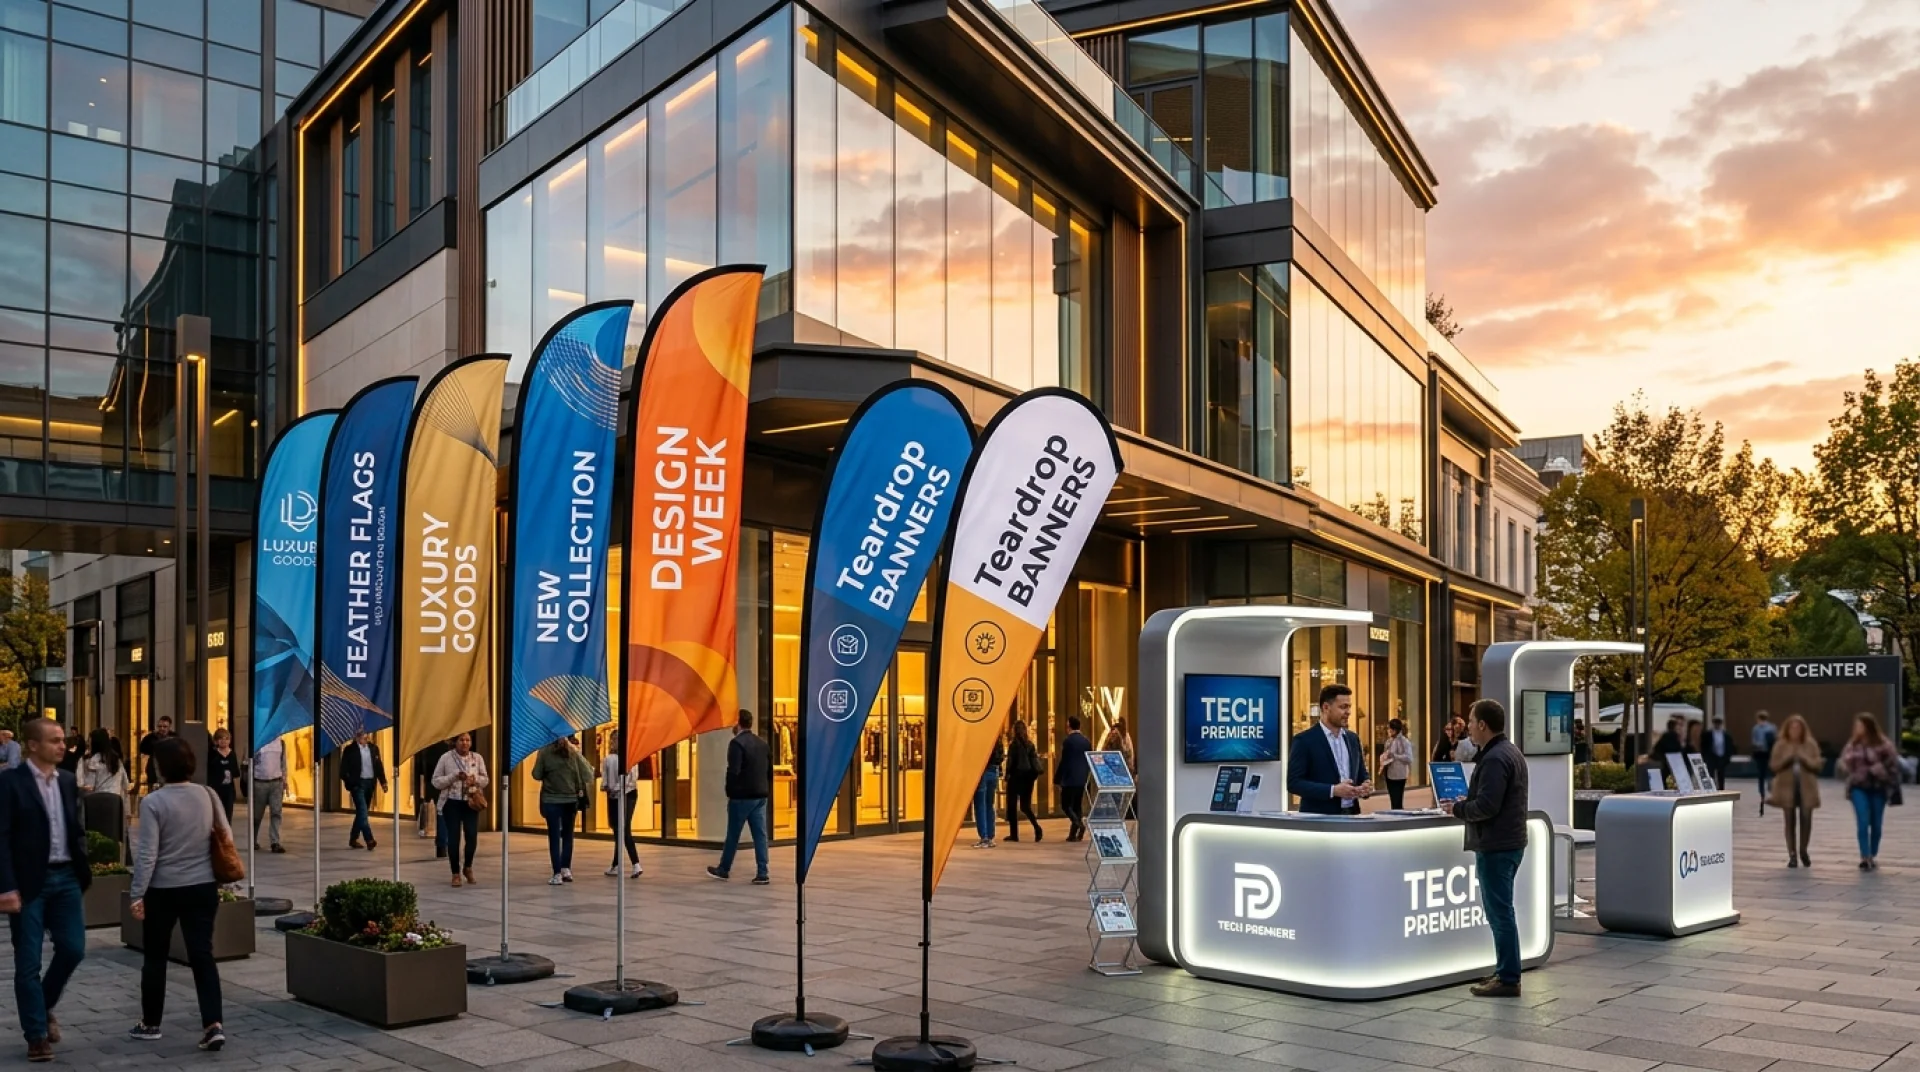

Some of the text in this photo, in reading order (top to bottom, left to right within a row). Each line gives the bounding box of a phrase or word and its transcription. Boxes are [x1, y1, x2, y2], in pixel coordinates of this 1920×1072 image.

[346, 451, 375, 678] FEATHER FLAGS
[567, 450, 596, 643] COLLECTION
[651, 426, 689, 590] DESIGN
[691, 437, 728, 566] WEEK
[836, 440, 927, 590] Teardrop
[868, 465, 951, 611] BANNERS
[973, 435, 1070, 587] Teardrop
[1007, 456, 1096, 608] BANNERS
[419, 511, 449, 653] LUXURY
[452, 544, 478, 653] GOODS
[536, 570, 561, 643] NEW
[1200, 697, 1264, 723] TECH
[1200, 725, 1264, 739] PREMIERE
[1733, 662, 1867, 679] EVENT CENTER
